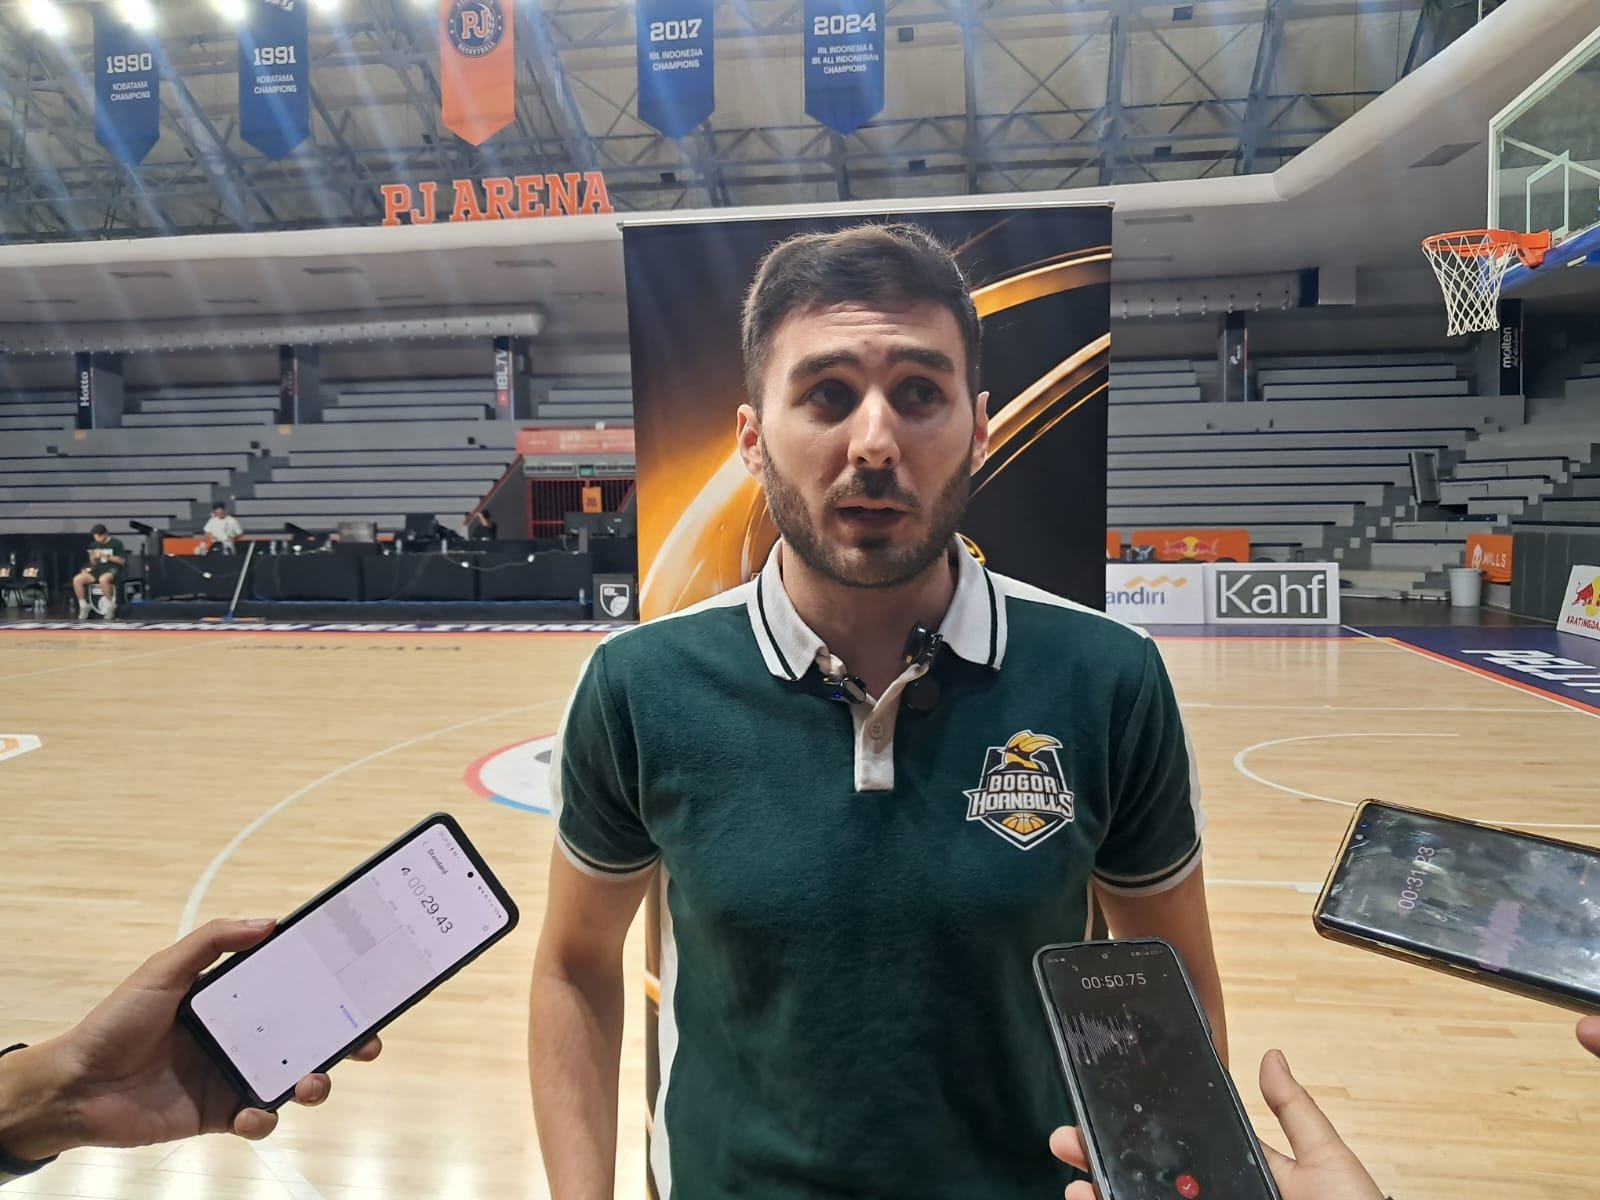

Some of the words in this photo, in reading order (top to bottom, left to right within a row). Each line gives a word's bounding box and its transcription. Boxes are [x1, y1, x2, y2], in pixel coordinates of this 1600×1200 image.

[461, 10, 490, 39] PJ
[650, 18, 702, 41] 2017
[814, 12, 877, 35] 2024
[106, 53, 152, 73] 1990
[253, 45, 297, 66] 1991
[661, 48, 704, 59] INDONESIA
[652, 59, 700, 71] CHAMPIONS
[823, 64, 867, 74] CHAMPIONS
[110, 91, 150, 101] CHAMPIONS
[254, 85, 297, 94] CHAMPIONS
[380, 181, 437, 226] PJ
[449, 171, 614, 223] ARENA
[1501, 326, 1512, 368] molten
[80, 371, 90, 407] Hotto
[1483, 551, 1506, 569] MILLS
[1106, 586, 1165, 605] andiri
[1220, 573, 1325, 614] Kahf
[988, 774, 1058, 794] BOGOR
[970, 791, 1073, 820] HORNBILLS
[427, 848, 449, 875] Standard
[1081, 972, 1147, 990] 00:50.75
